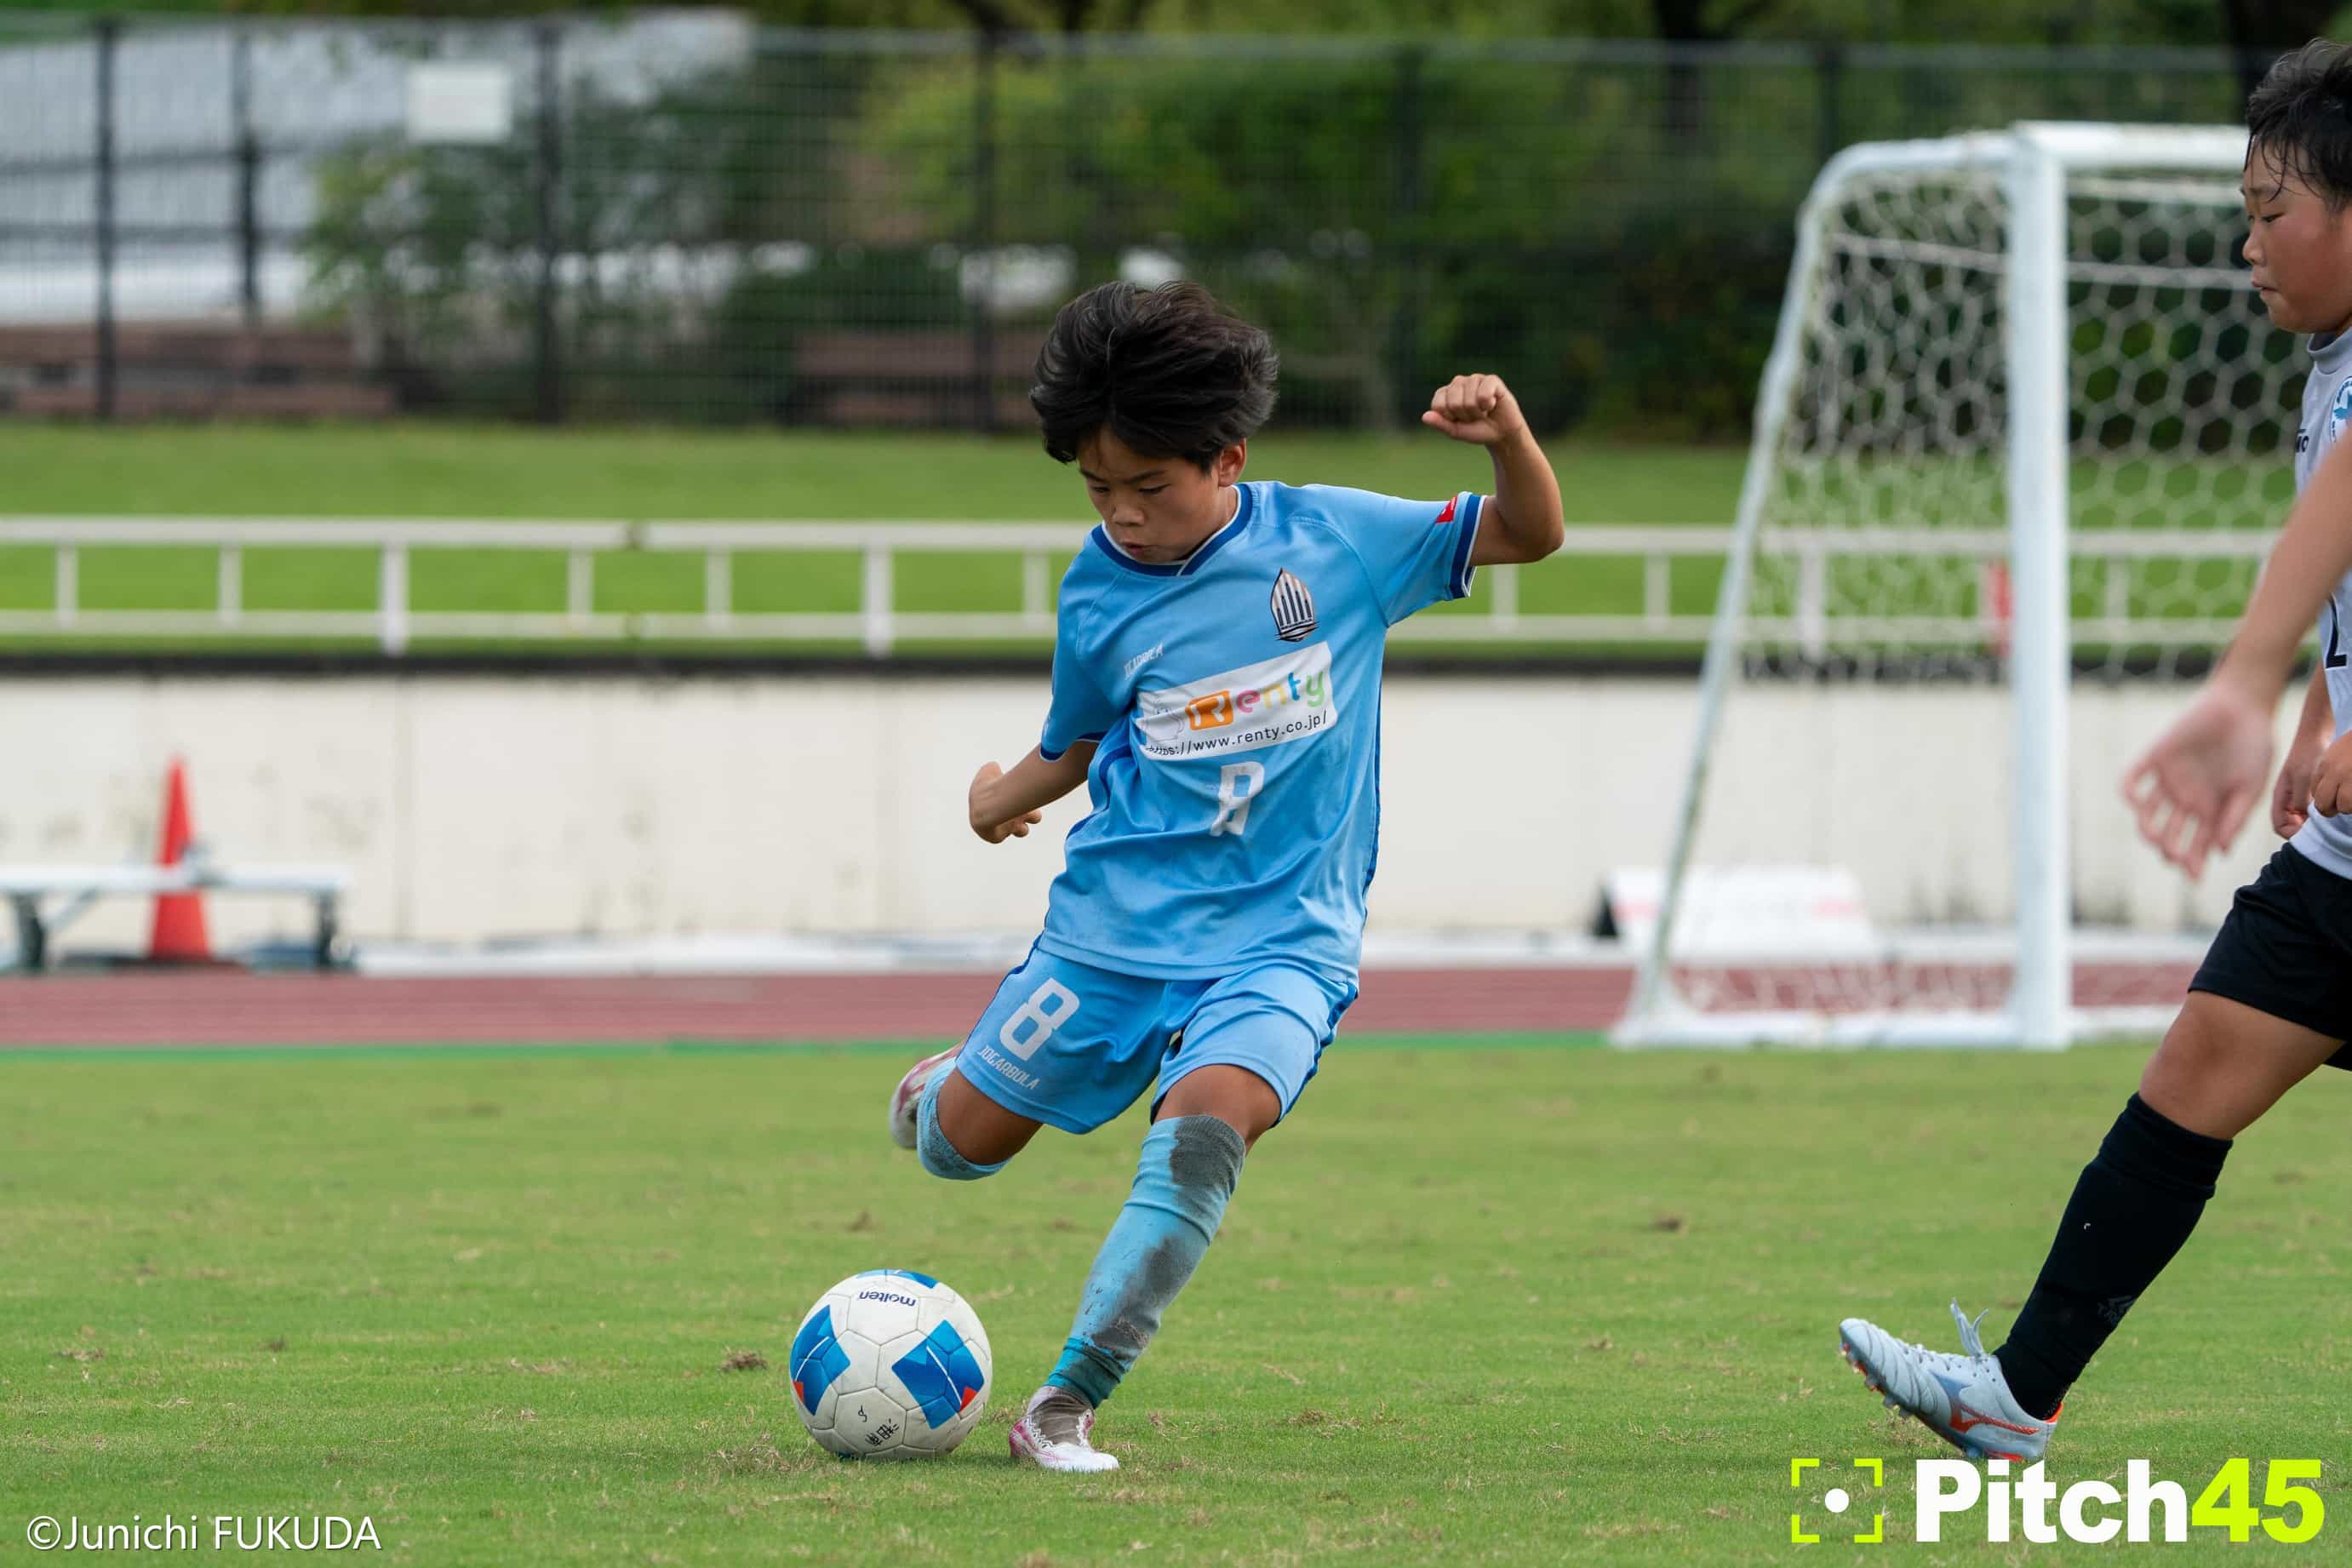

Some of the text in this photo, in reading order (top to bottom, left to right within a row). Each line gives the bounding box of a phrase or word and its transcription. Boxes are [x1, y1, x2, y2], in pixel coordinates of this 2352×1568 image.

[1185, 670, 1325, 730] Renty
[999, 977, 1080, 1062] 8
[977, 1044, 1040, 1090] JOGARBOLA
[859, 1290, 917, 1307] molten
